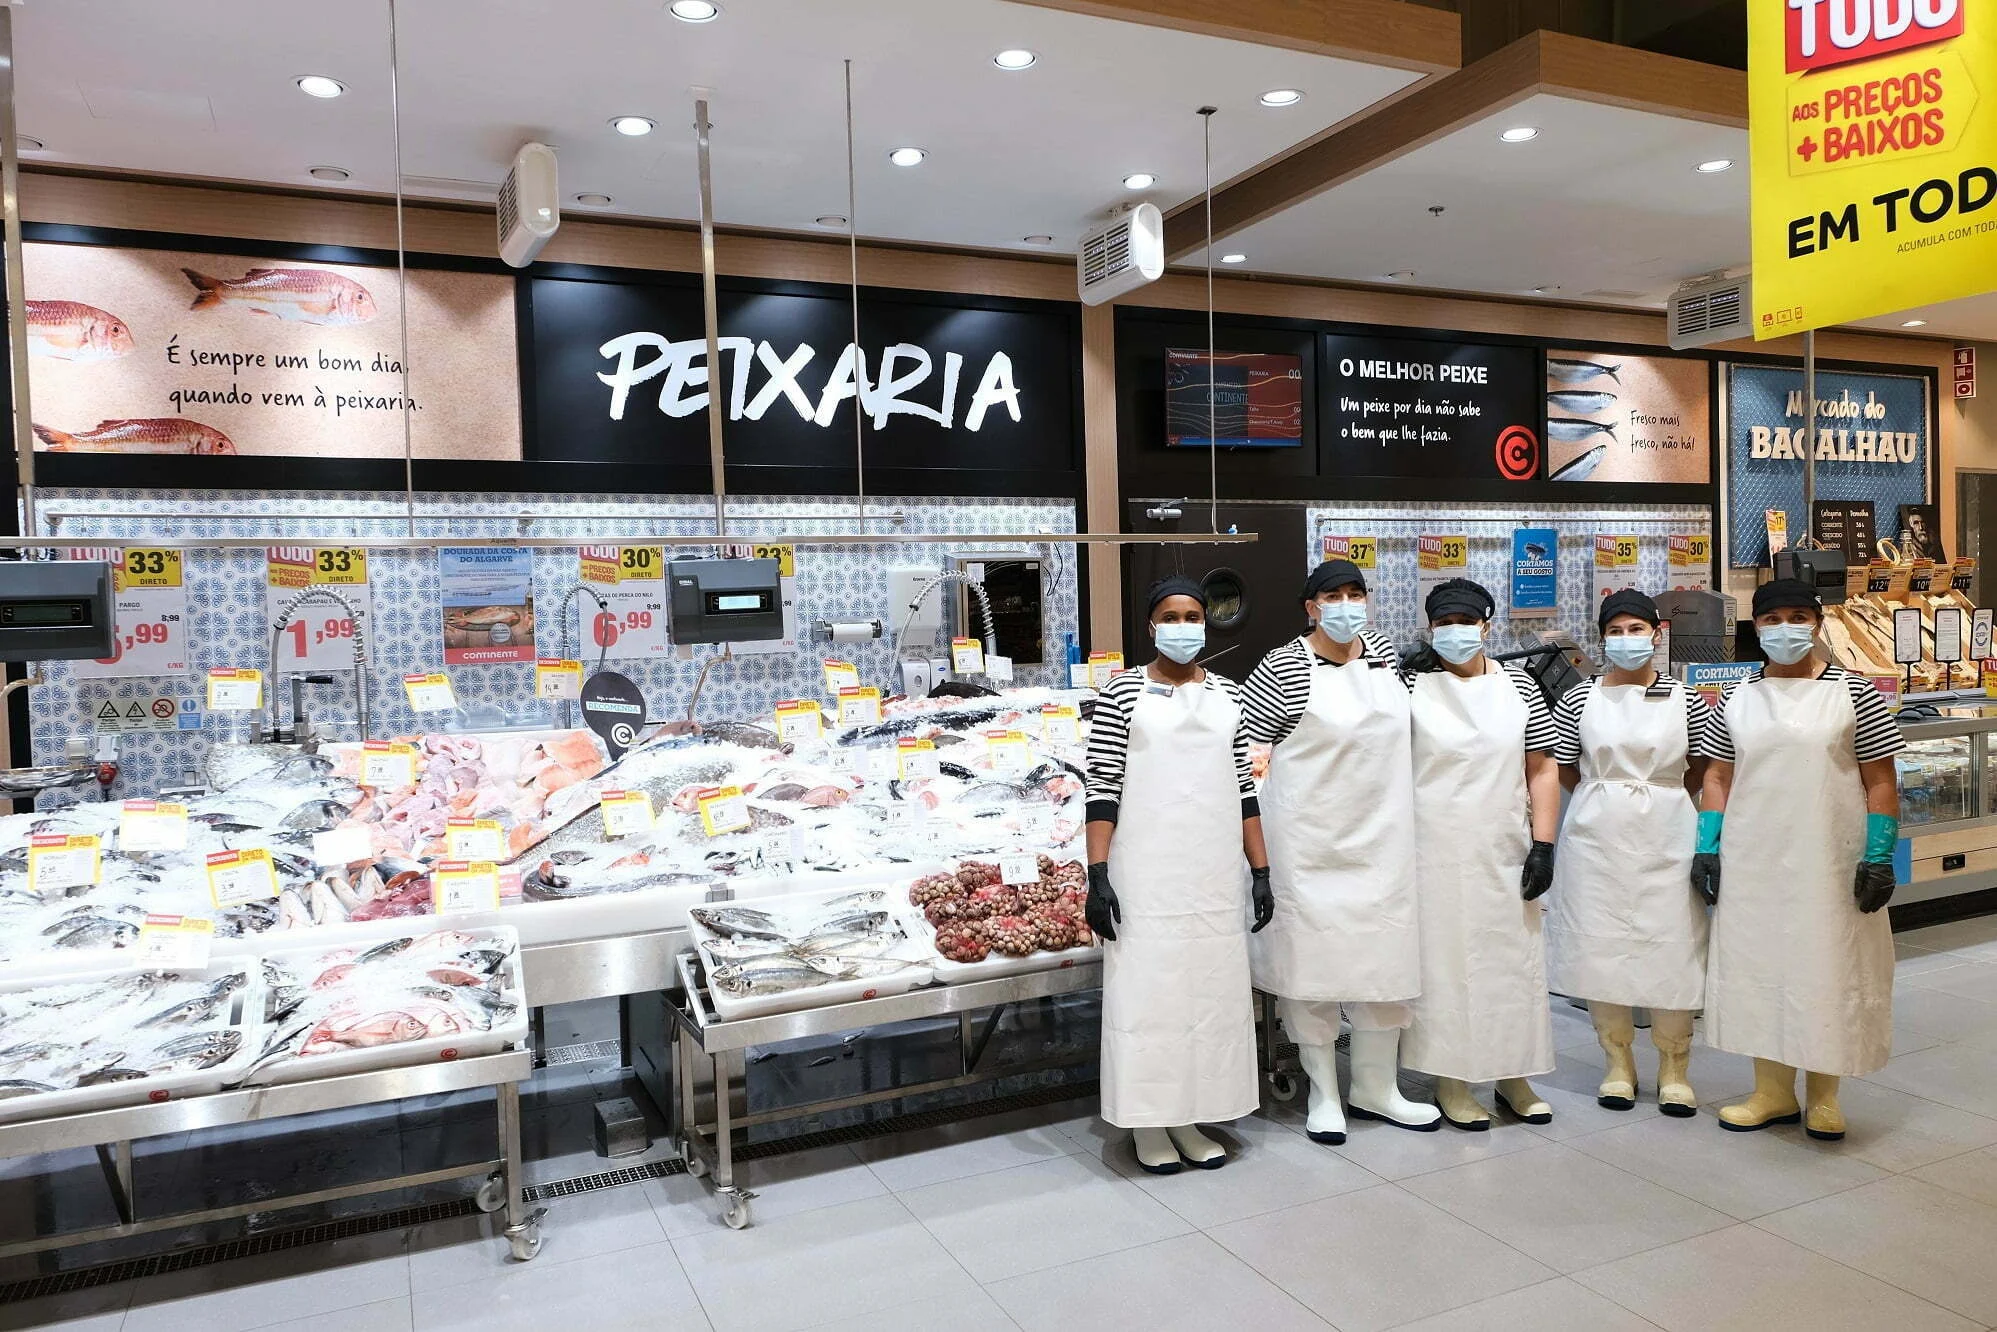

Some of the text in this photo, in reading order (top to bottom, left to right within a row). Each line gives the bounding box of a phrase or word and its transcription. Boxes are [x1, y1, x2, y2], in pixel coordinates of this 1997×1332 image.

[1793, 68, 1942, 123] AOS PREÇOS
[1824, 109, 1944, 162] BAIXOS
[1788, 203, 1860, 259] EM
[1896, 220, 1997, 254] ACUMULA COM TOD
[167, 334, 181, 365] É
[190, 350, 266, 374] sempre
[274, 353, 308, 370] um
[318, 348, 363, 372] bom
[597, 331, 1022, 432] PEIXARIA
[1339, 358, 1488, 384] O MELHOR PEIXE
[168, 385, 424, 417] quando vem à peixaria.
[1340, 396, 1481, 419] Um peixe por dia não sabe
[1786, 388, 1886, 420] Mrcado do
[1631, 409, 1680, 428] Fresco mais
[1341, 421, 1452, 447] o bem que lhe fazia.
[1631, 434, 1696, 453] fresco, não há!
[487, 547, 498, 555] DA
[500, 546, 528, 555] COSTA
[1325, 538, 1375, 560] TUDO 37%
[1420, 537, 1466, 558] TUDO 33%
[1596, 537, 1616, 550] TUDO
[1670, 536, 1689, 550] TUDO
[129, 550, 179, 574] 33%
[271, 546, 364, 572] TUDO 33%
[475, 555, 513, 563] ALGARVE
[623, 547, 661, 569] 30%
[593, 611, 652, 648] 6,99
[1695, 665, 1752, 680] CORTAMOS
[588, 702, 638, 712] RECOMENDA
